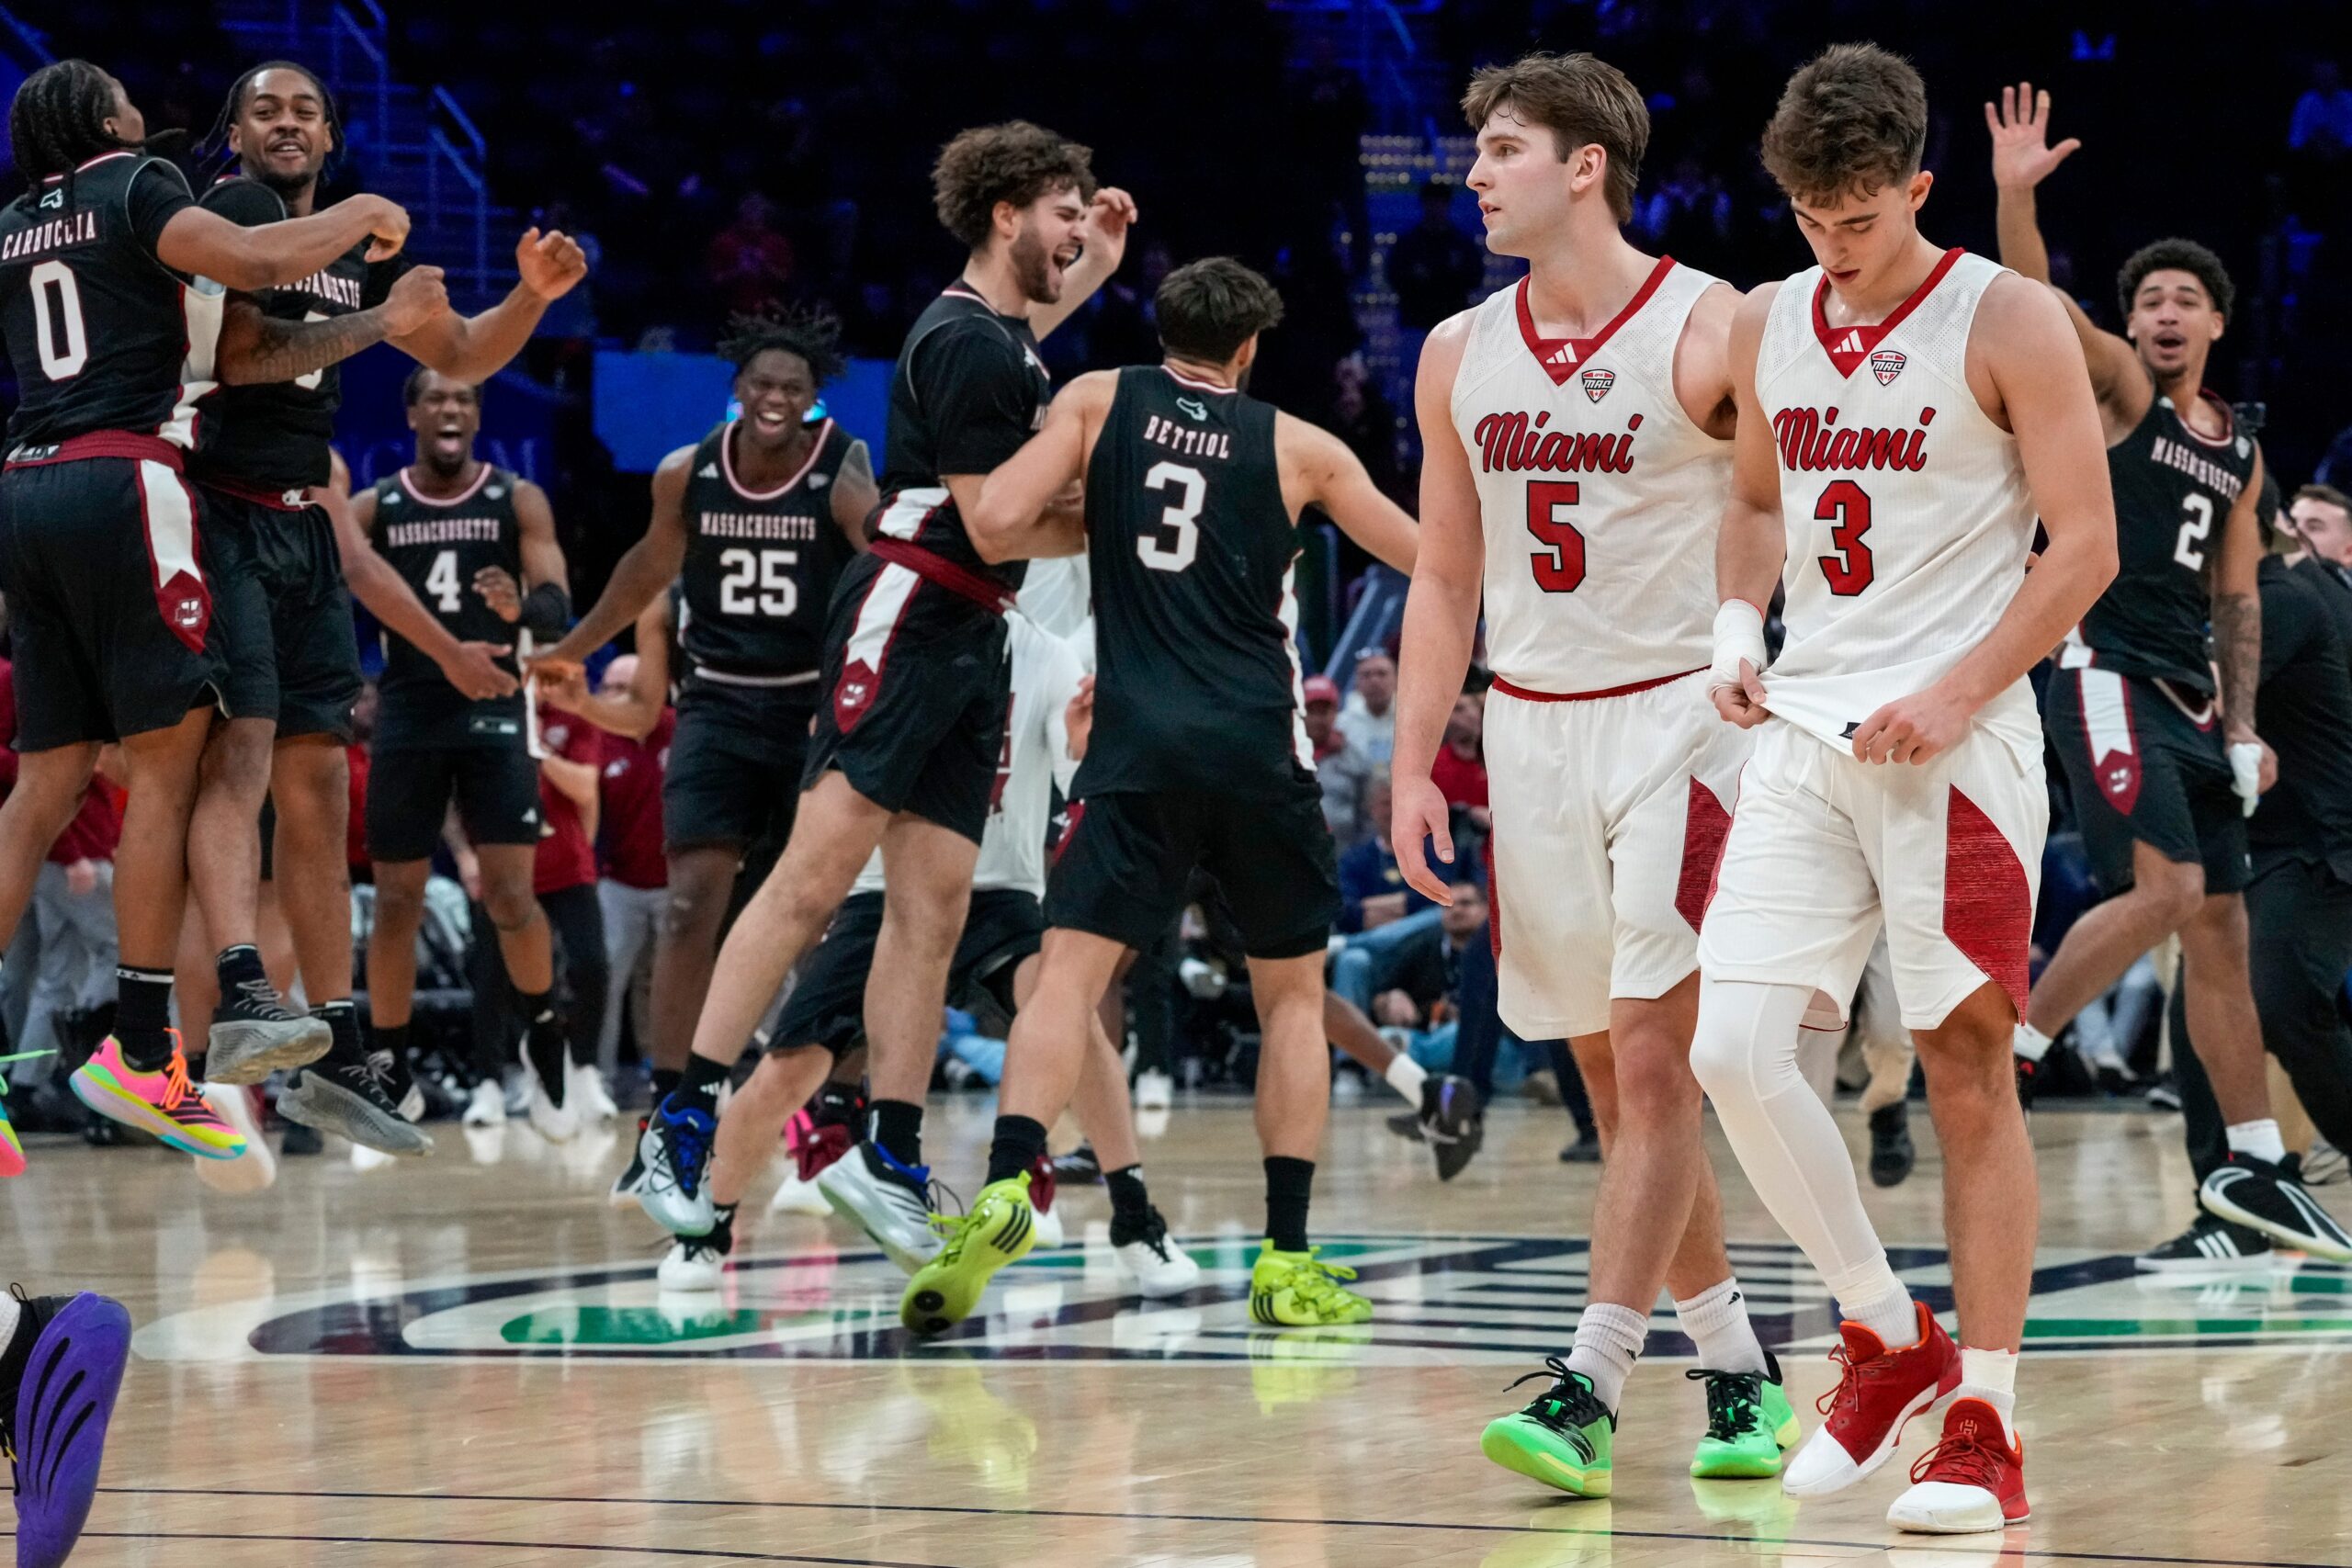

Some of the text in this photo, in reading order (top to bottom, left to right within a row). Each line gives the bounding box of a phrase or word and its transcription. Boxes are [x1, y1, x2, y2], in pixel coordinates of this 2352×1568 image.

[2, 211, 96, 260] CARBUCCIA
[29, 259, 88, 381] 0
[1584, 379, 1612, 389] MAC
[1872, 361, 1904, 370] MAC
[1144, 414, 1229, 459] BETTIOL
[1474, 411, 1644, 474] Miami
[1772, 406, 1937, 472] Miami
[1136, 460, 1207, 572] 3
[1526, 479, 1586, 593] 5
[1814, 479, 1874, 597] 3
[2174, 492, 2213, 572] 2
[425, 550, 461, 612] 4
[719, 548, 797, 615] 25
